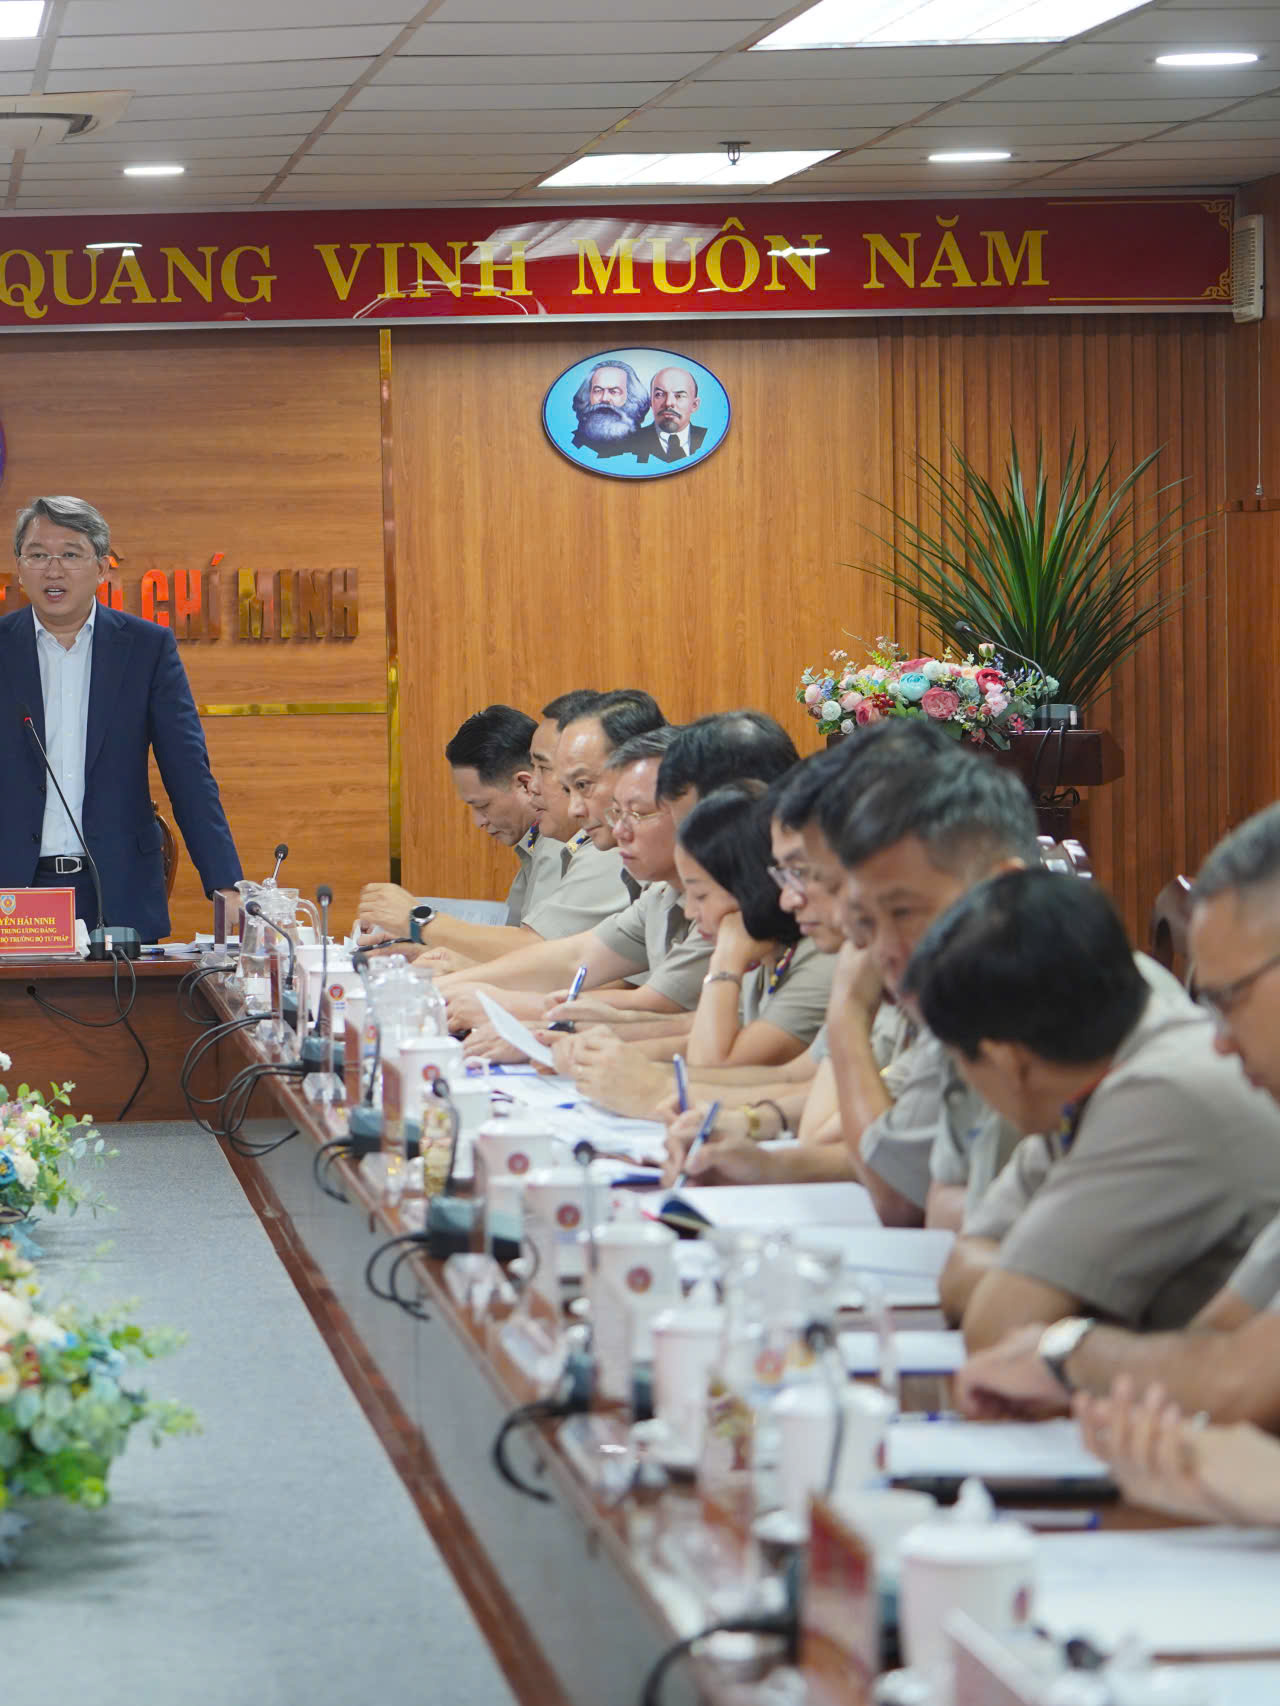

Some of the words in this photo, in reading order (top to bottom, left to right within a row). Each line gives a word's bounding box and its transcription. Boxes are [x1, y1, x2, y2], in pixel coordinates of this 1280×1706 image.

[313, 241, 533, 301] VINH
[572, 217, 819, 295] MUÔN
[862, 215, 1049, 289] NĂM
[141, 552, 224, 640] CHÍ
[237, 567, 359, 639] MINH
[34, 917, 56, 925] NINH
